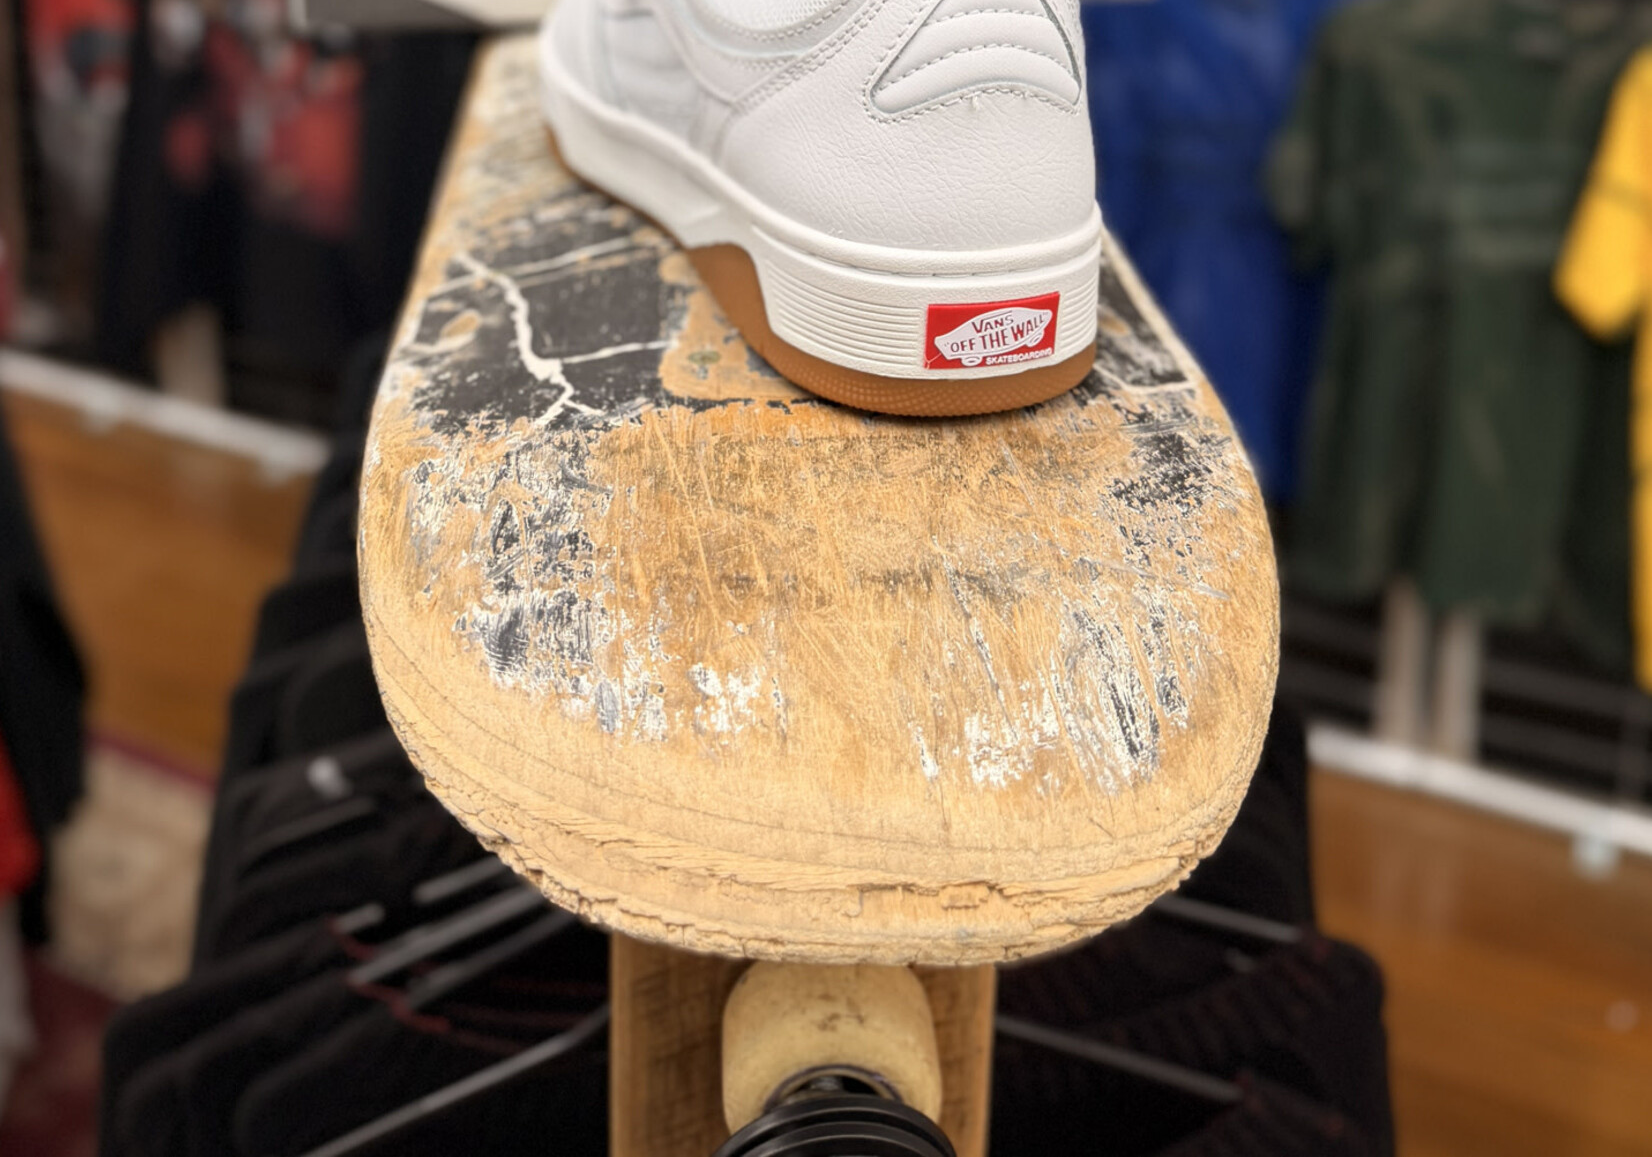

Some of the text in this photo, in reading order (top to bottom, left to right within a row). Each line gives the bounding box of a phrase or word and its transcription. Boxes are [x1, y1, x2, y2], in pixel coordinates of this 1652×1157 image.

[971, 310, 1014, 334] VANS
[980, 328, 1010, 350] THE
[985, 347, 1053, 365] SKATEBOARDING
